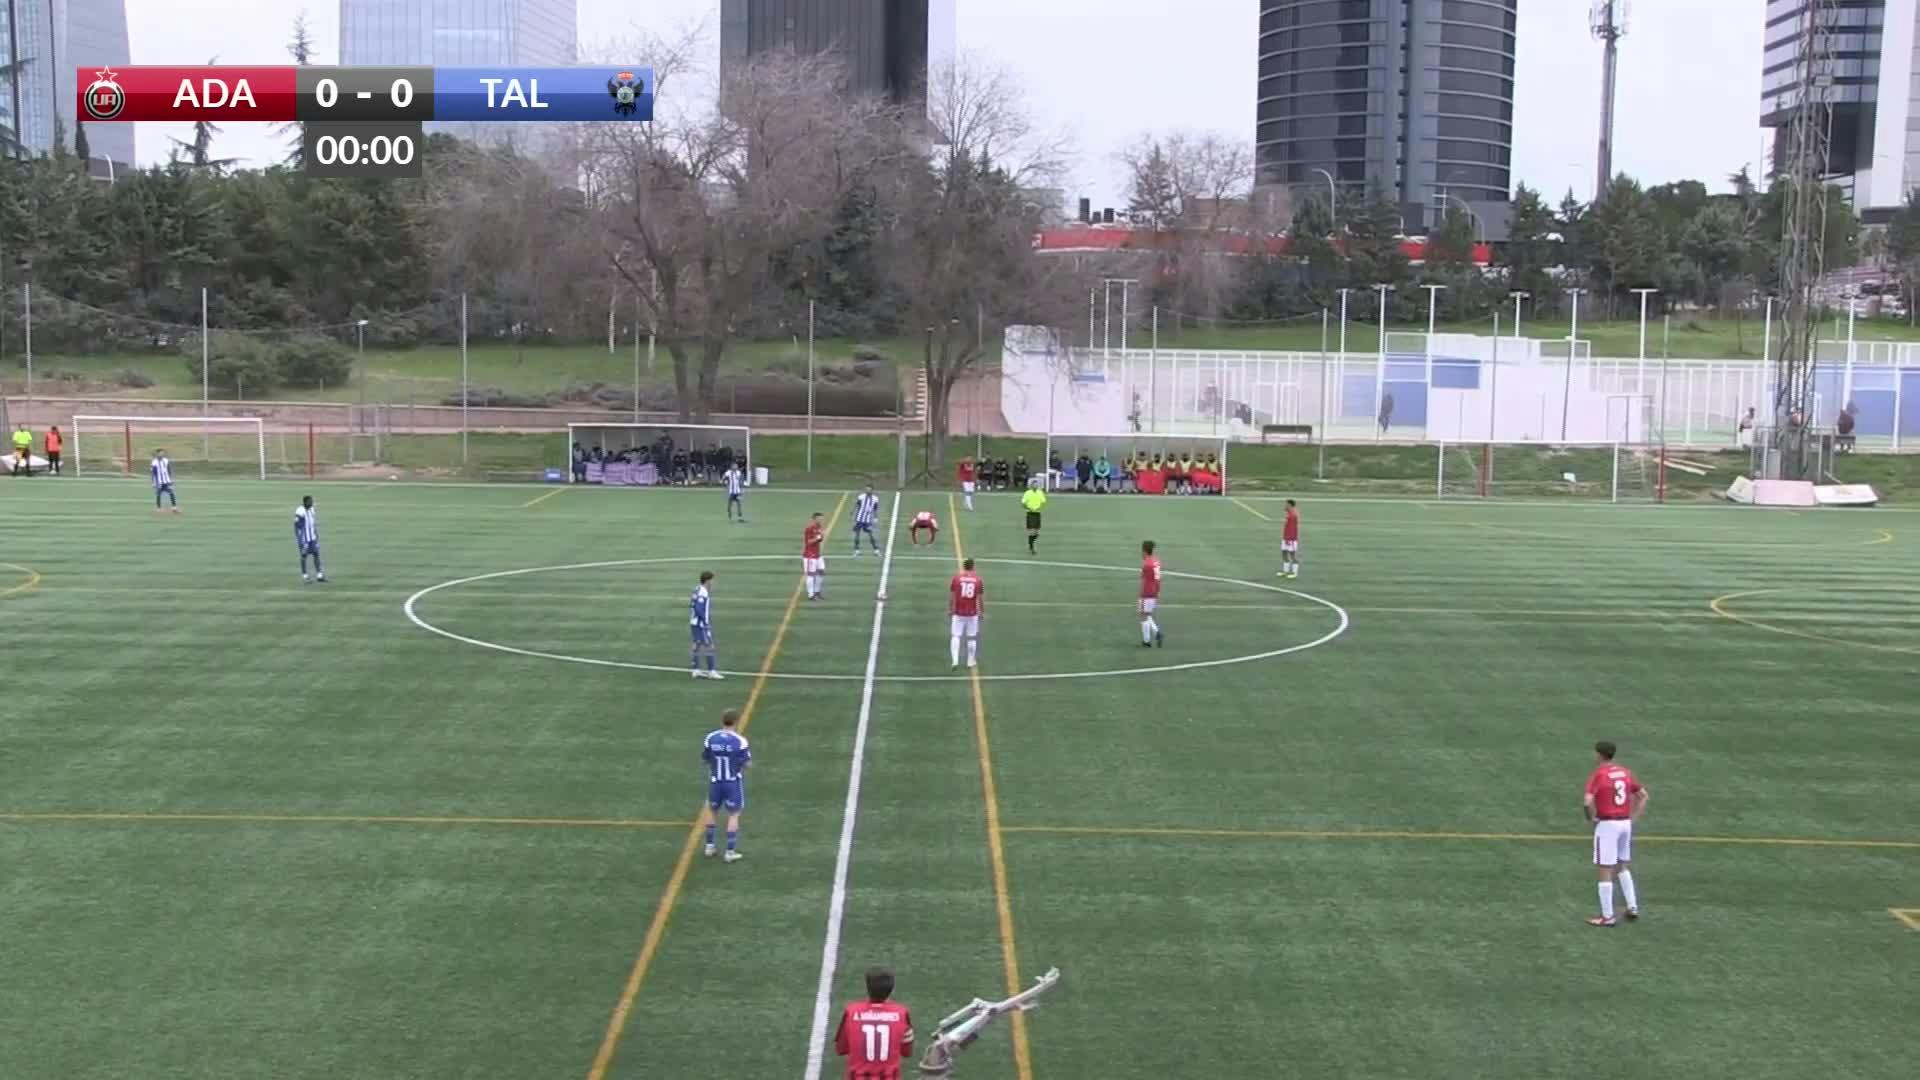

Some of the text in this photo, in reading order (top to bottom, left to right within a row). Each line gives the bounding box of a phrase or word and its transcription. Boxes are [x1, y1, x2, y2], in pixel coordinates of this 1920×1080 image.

[960, 581, 976, 599] 18
[1614, 780, 1626, 805] 3
[861, 1024, 890, 1062] 11
